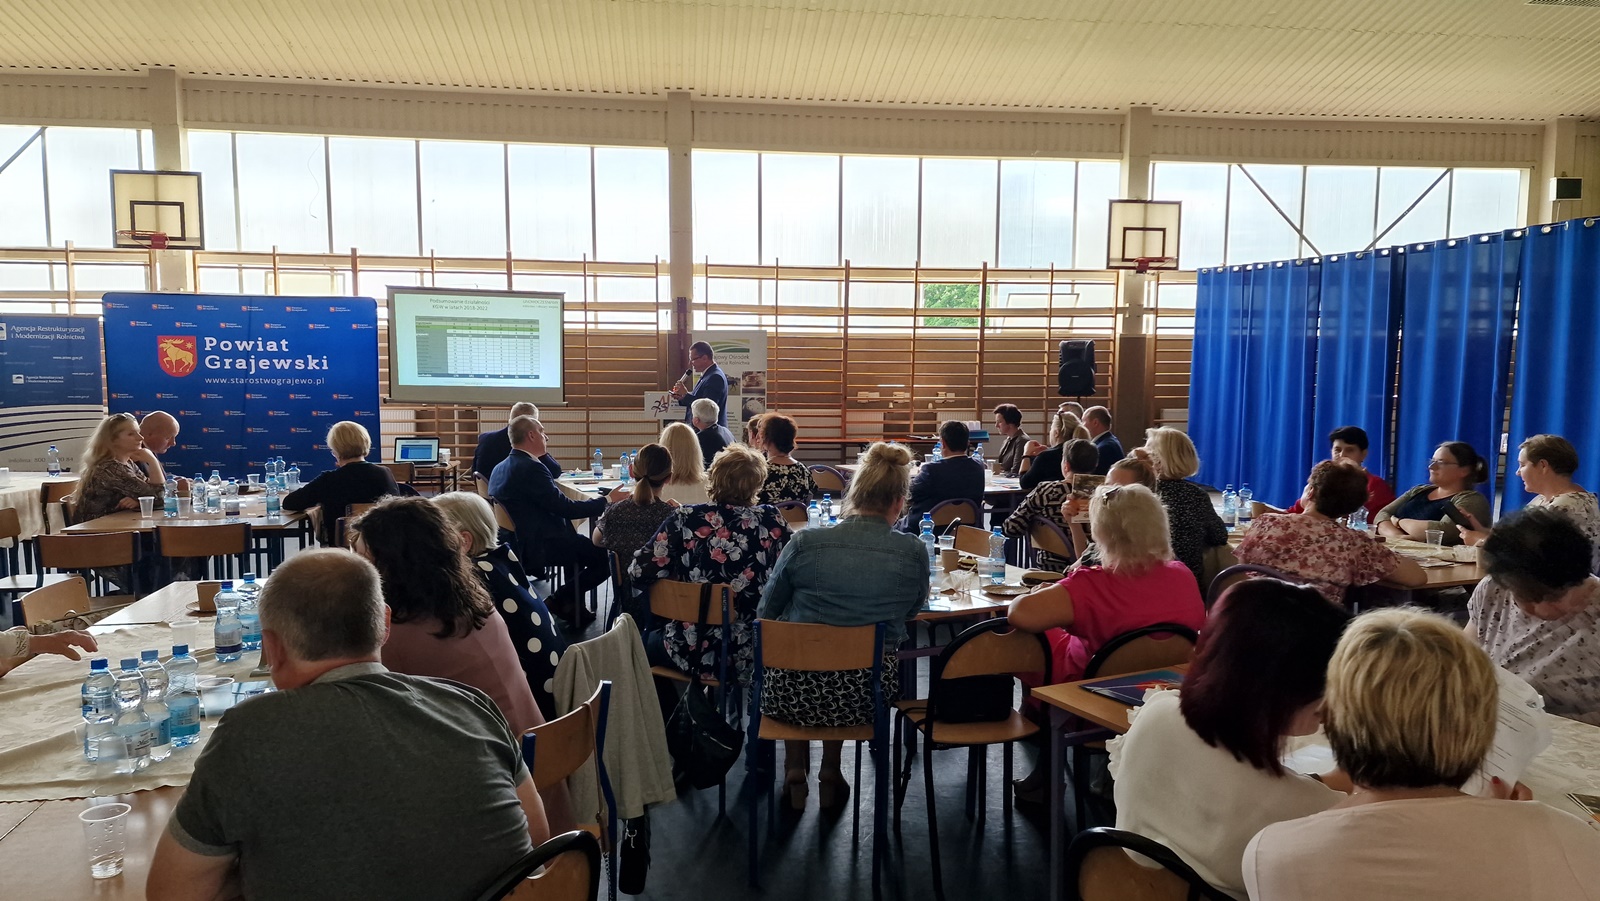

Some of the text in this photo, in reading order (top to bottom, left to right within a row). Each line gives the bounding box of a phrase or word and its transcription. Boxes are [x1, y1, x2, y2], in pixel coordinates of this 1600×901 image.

[10, 325, 85, 333] Agencja Restrukturyzacji
[15, 333, 55, 341] Modernizacji
[204, 336, 289, 352] Powiat
[204, 354, 329, 375] Grajewski
[204, 377, 325, 386] www.starostwograjewo.pl
